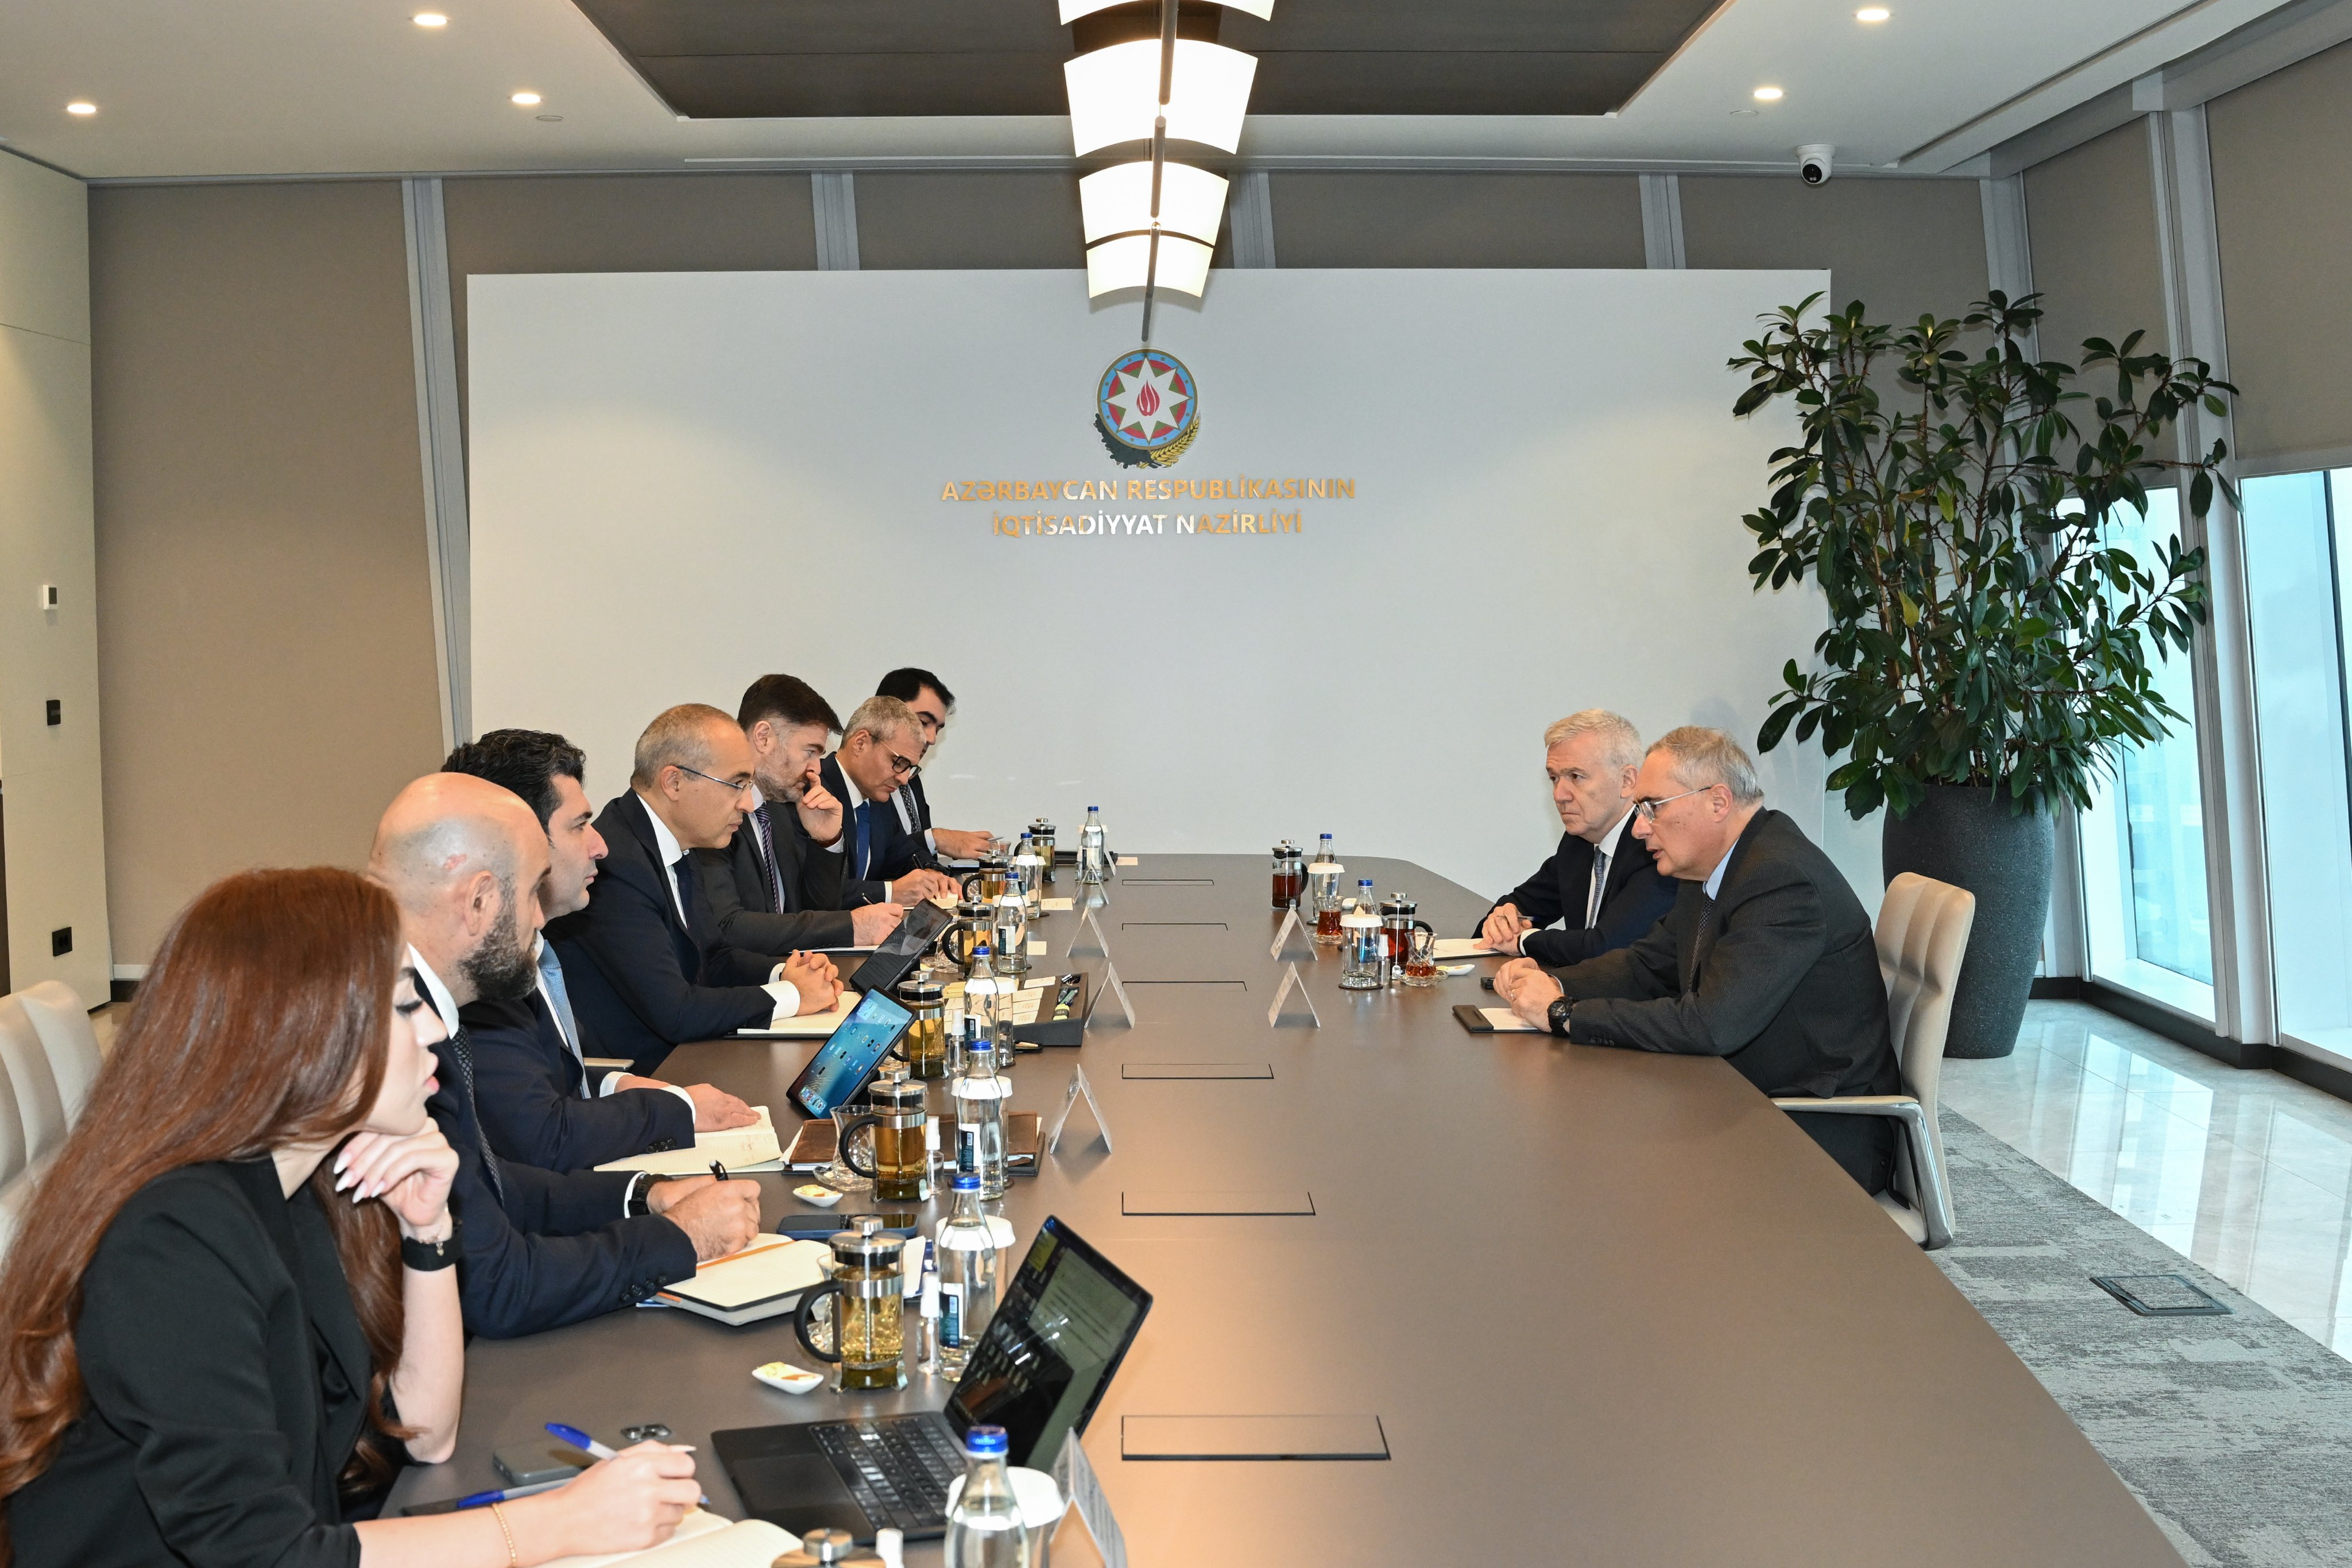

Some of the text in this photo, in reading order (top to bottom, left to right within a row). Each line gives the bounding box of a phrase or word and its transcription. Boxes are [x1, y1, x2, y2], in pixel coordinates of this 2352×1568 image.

[941, 474, 1356, 501] AZƏRBAYCAN RESPUBLİKASININ
[993, 508, 1302, 538] İQTİSADİYYAT NAZİRLİYİ
